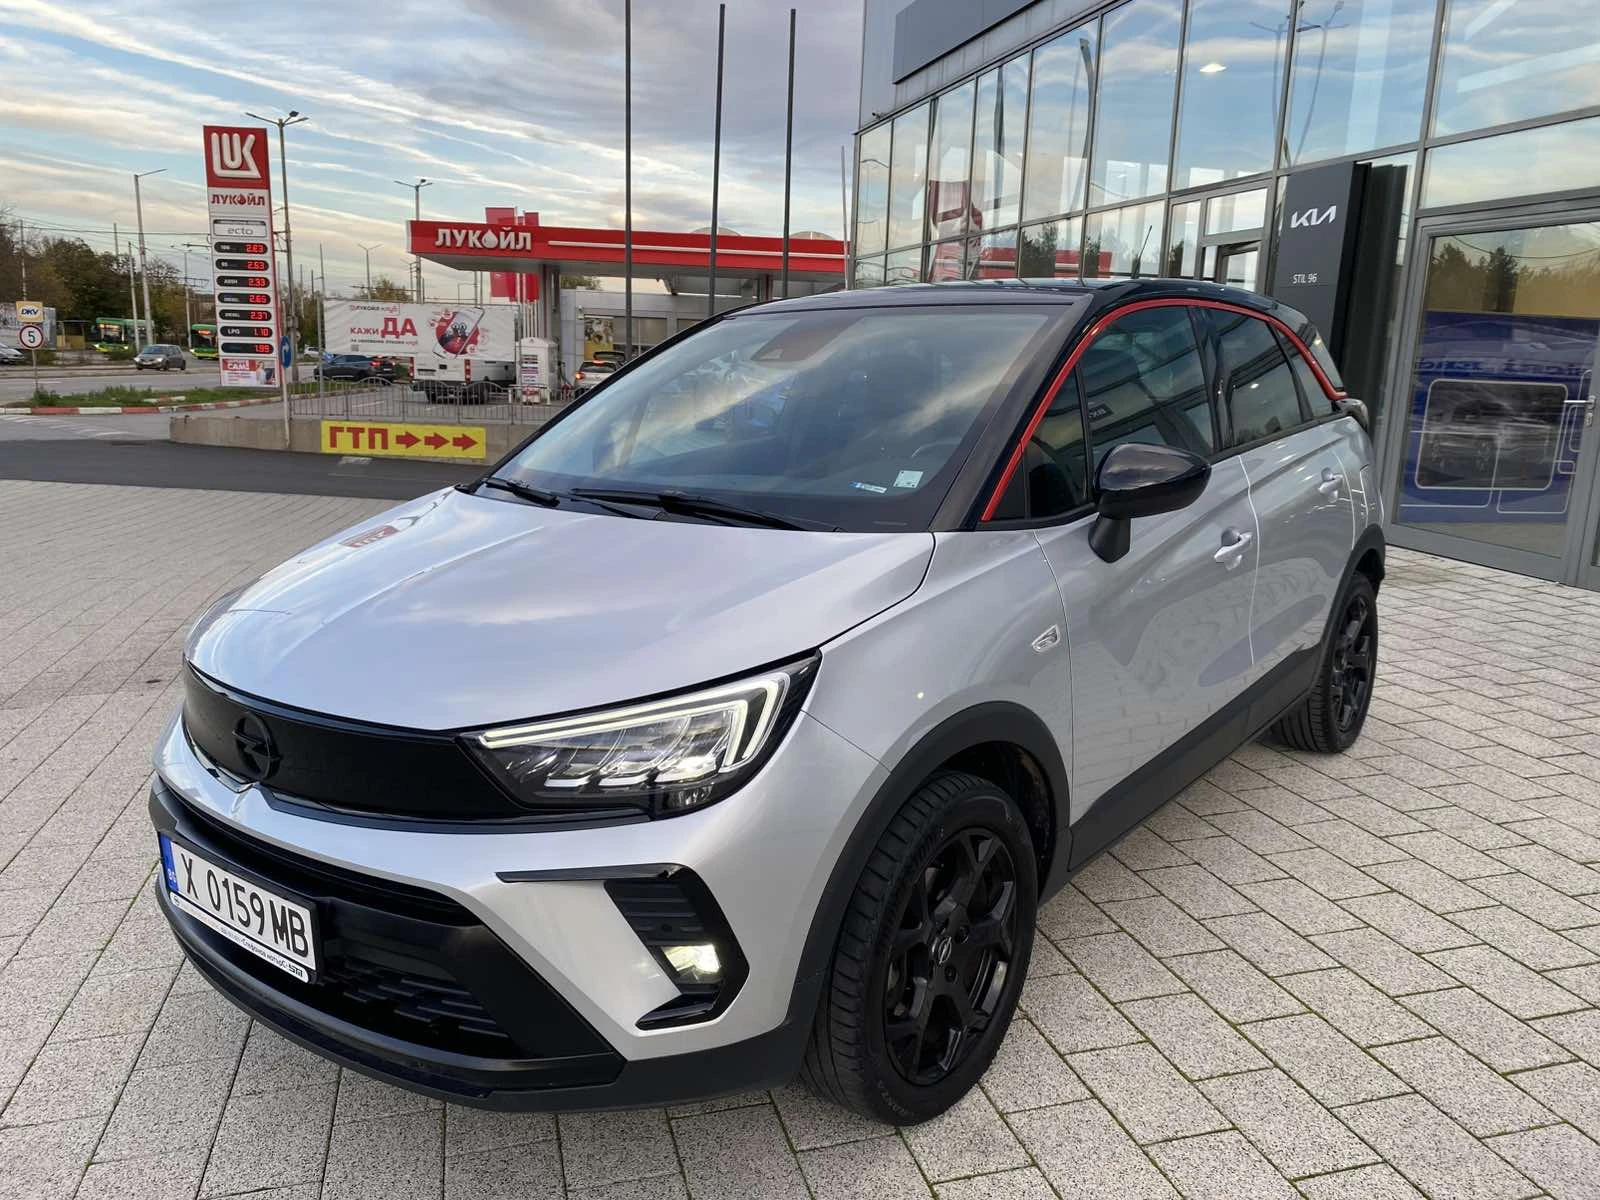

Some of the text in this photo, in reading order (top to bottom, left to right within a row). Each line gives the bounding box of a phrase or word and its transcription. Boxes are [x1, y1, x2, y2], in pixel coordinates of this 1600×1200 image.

[211, 193, 265, 206] ЛУКОЙЛ
[1290, 205, 1337, 228] KIA
[227, 226, 254, 235] ecto
[435, 226, 532, 251] ЛУКОЙЛ
[1293, 272, 1318, 284] STIL 96
[28, 331, 36, 343] 5
[350, 317, 418, 339] КАЖИ ДА
[329, 426, 389, 450] ГТП
[181, 853, 199, 899] X
[207, 869, 265, 936] 0159
[269, 899, 309, 958] MB
